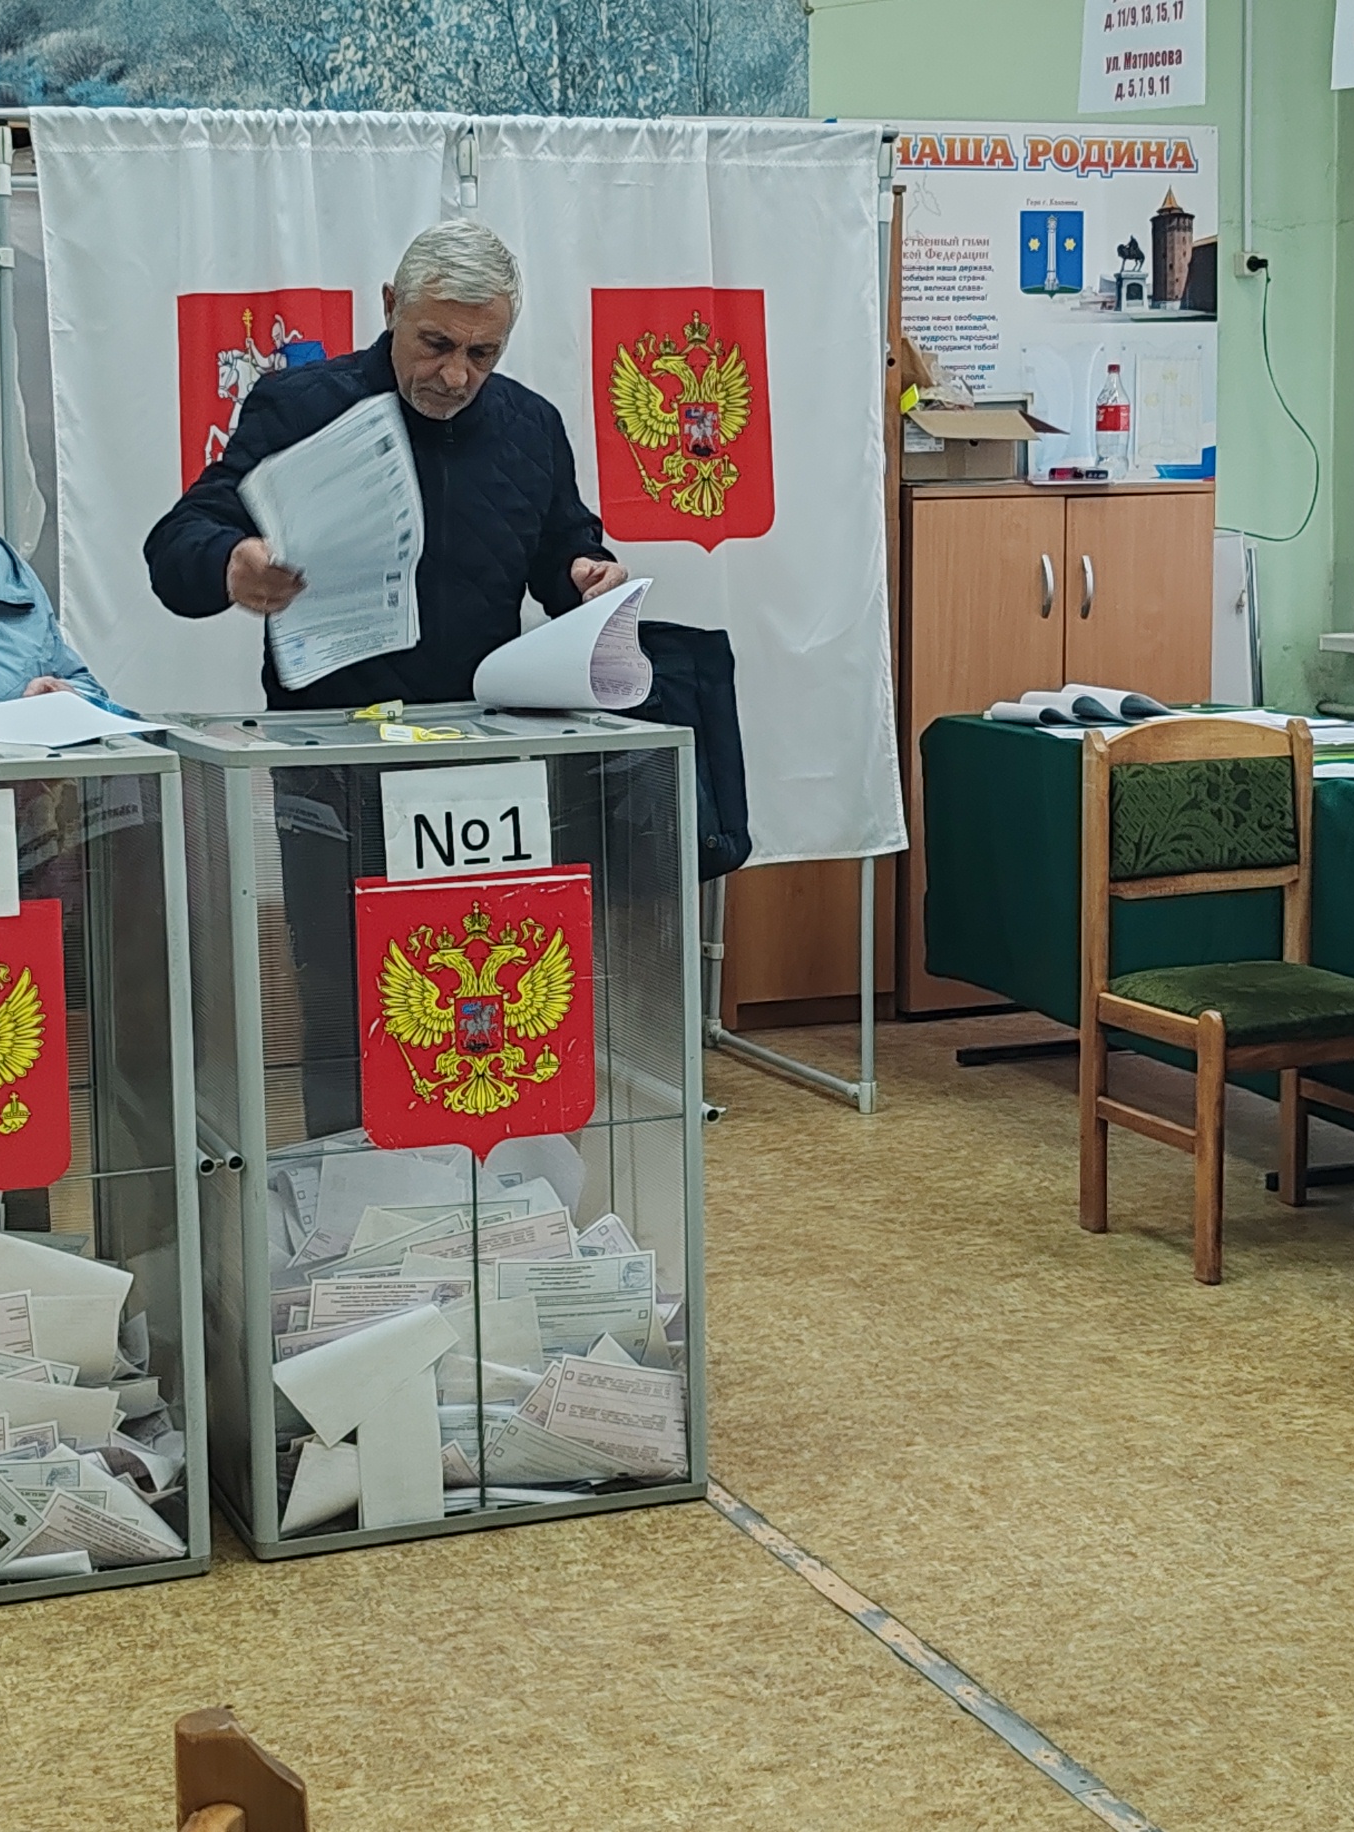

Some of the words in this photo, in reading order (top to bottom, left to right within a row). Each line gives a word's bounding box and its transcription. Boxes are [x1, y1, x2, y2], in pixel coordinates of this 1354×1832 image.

[1104, 13, 1114, 32] д.
[1117, 6, 1138, 27] 11/9,
[1141, 4, 1154, 24] 13,
[1156, 2, 1170, 23] 15,
[1173, 0, 1184, 20] 17
[1106, 56, 1121, 74] ул.
[1124, 49, 1183, 70] Матросова
[1114, 83, 1125, 101] д.
[1128, 79, 1137, 99] 5,
[1148, 76, 1157, 97] 9,
[1159, 75, 1170, 95] 11
[1026, 136, 1197, 176] РОДИНА
[902, 236, 960, 247] ственный
[925, 248, 989, 262] Федерации
[414, 806, 532, 869] №1
